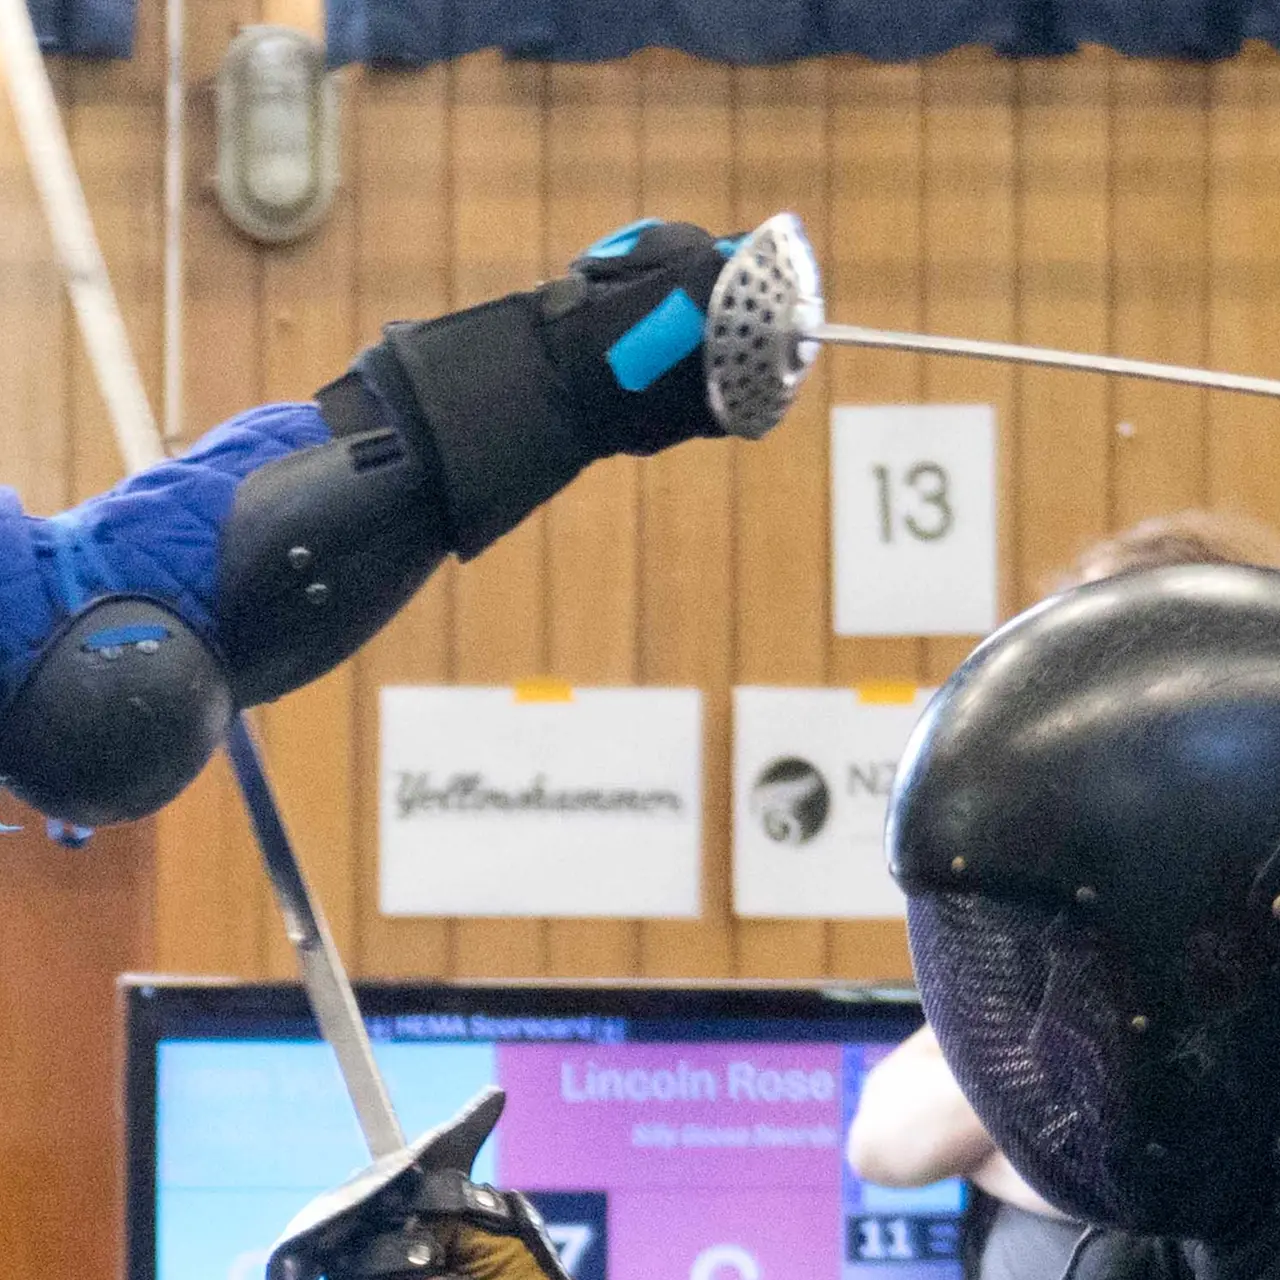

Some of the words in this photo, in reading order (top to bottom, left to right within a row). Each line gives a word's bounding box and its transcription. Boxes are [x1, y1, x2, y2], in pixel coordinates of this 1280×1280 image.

[872, 461, 954, 544] 13
[560, 1062, 716, 1101] Lincoln
[727, 1062, 835, 1101] Rose
[860, 1220, 913, 1258] 11
